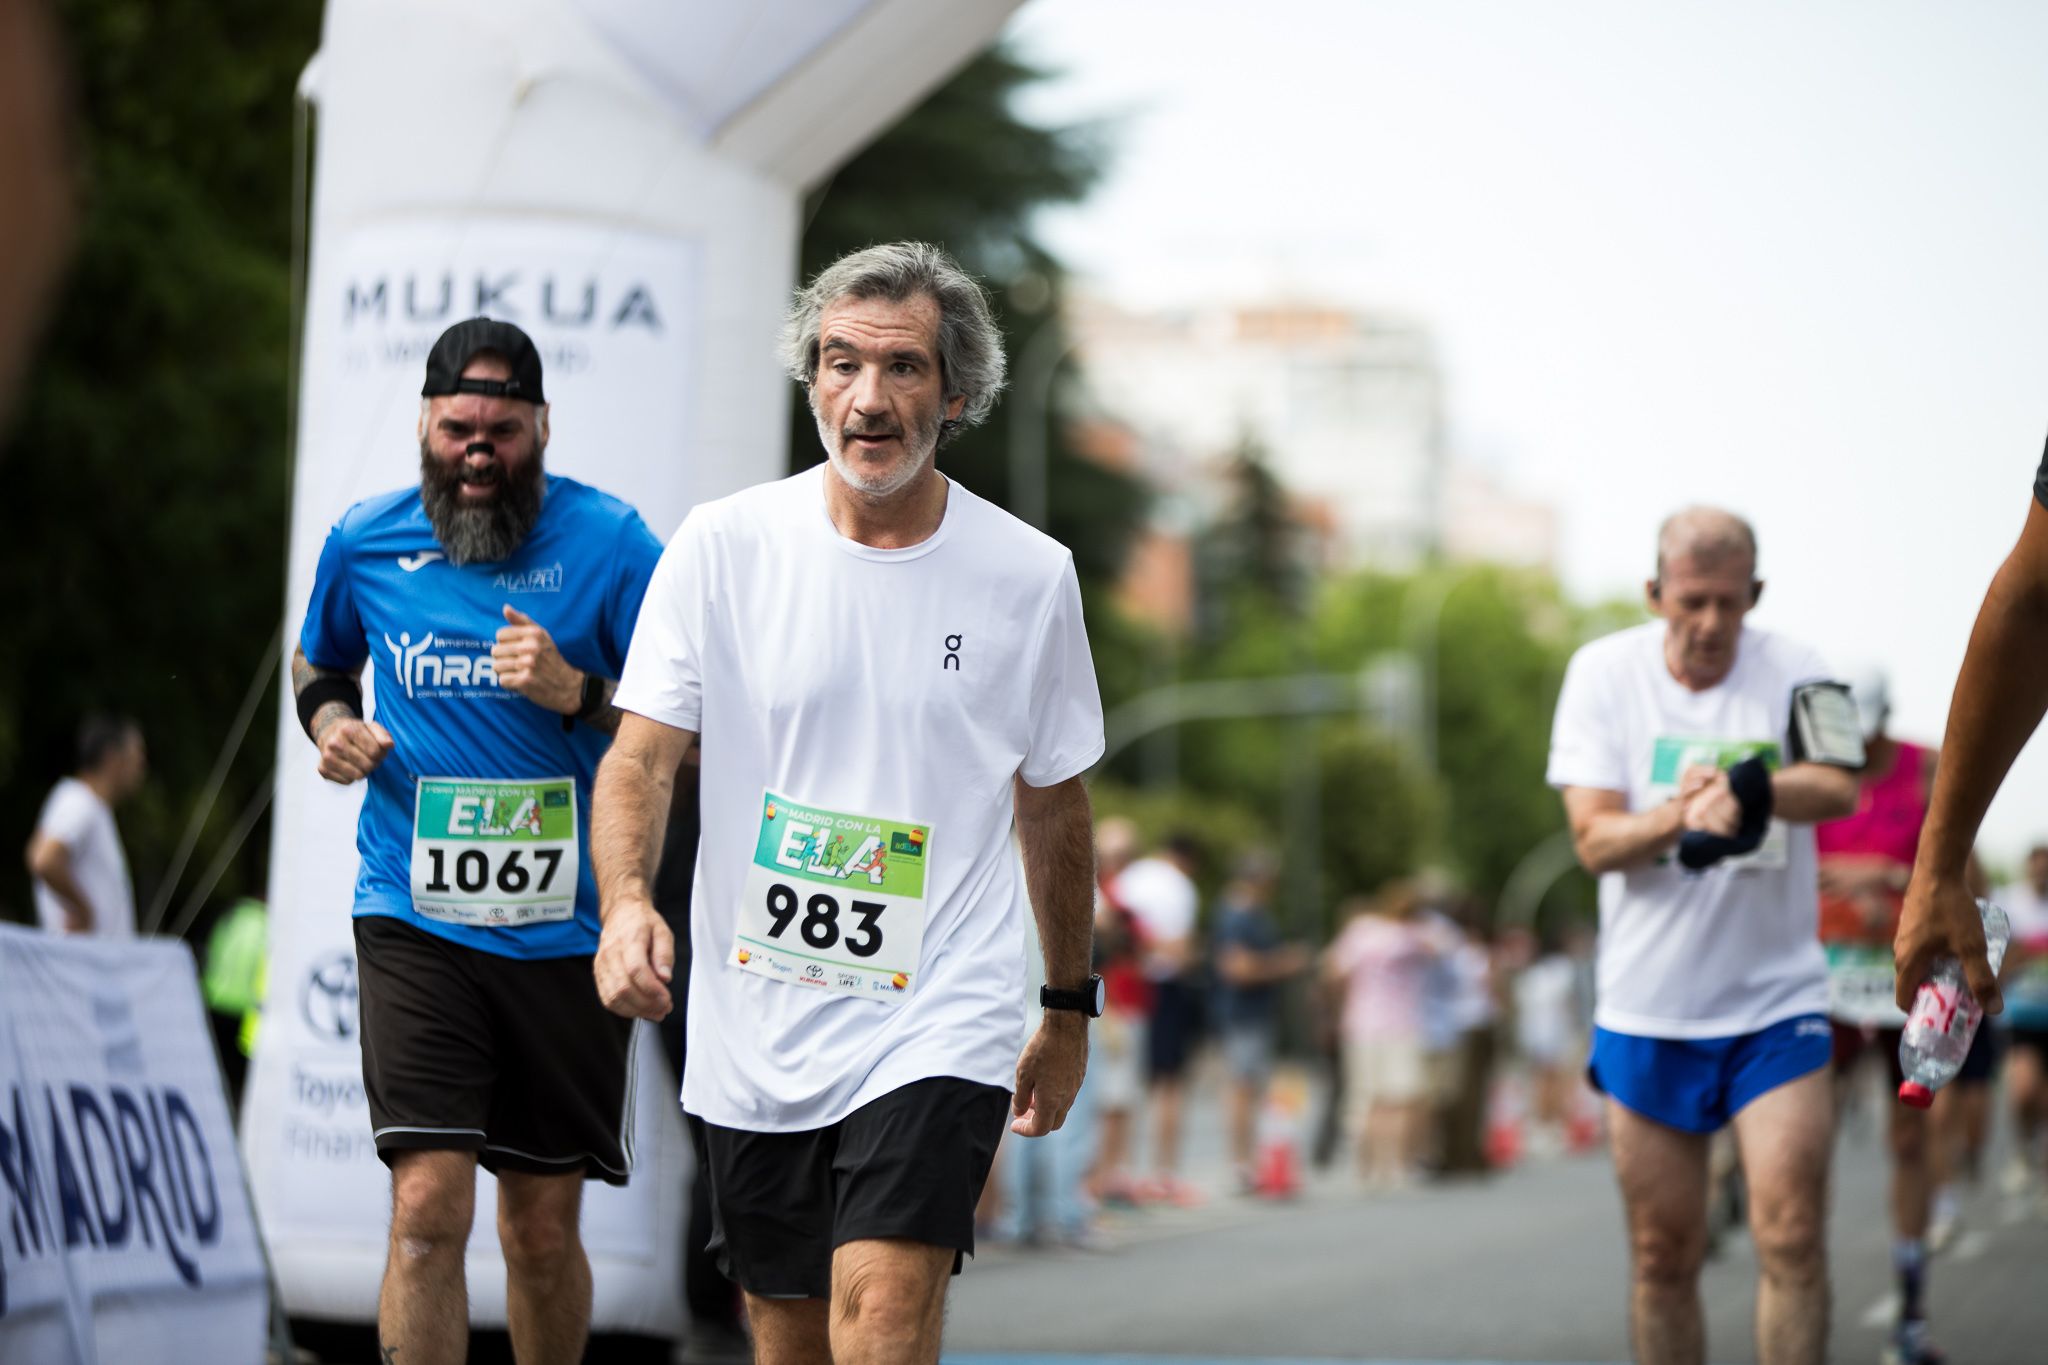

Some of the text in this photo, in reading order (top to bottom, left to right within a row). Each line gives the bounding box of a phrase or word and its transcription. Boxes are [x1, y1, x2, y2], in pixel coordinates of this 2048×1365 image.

[342, 266, 665, 336] MUKUA
[455, 786, 497, 797] MADRID
[499, 787, 522, 797] CON
[523, 788, 536, 797] LA
[448, 797, 541, 836] ELA
[788, 808, 834, 827] MADRID
[836, 818, 864, 831] CON
[866, 823, 881, 834] LA
[426, 848, 564, 894] 1067
[776, 820, 888, 885] ELA
[766, 883, 887, 958] 983
